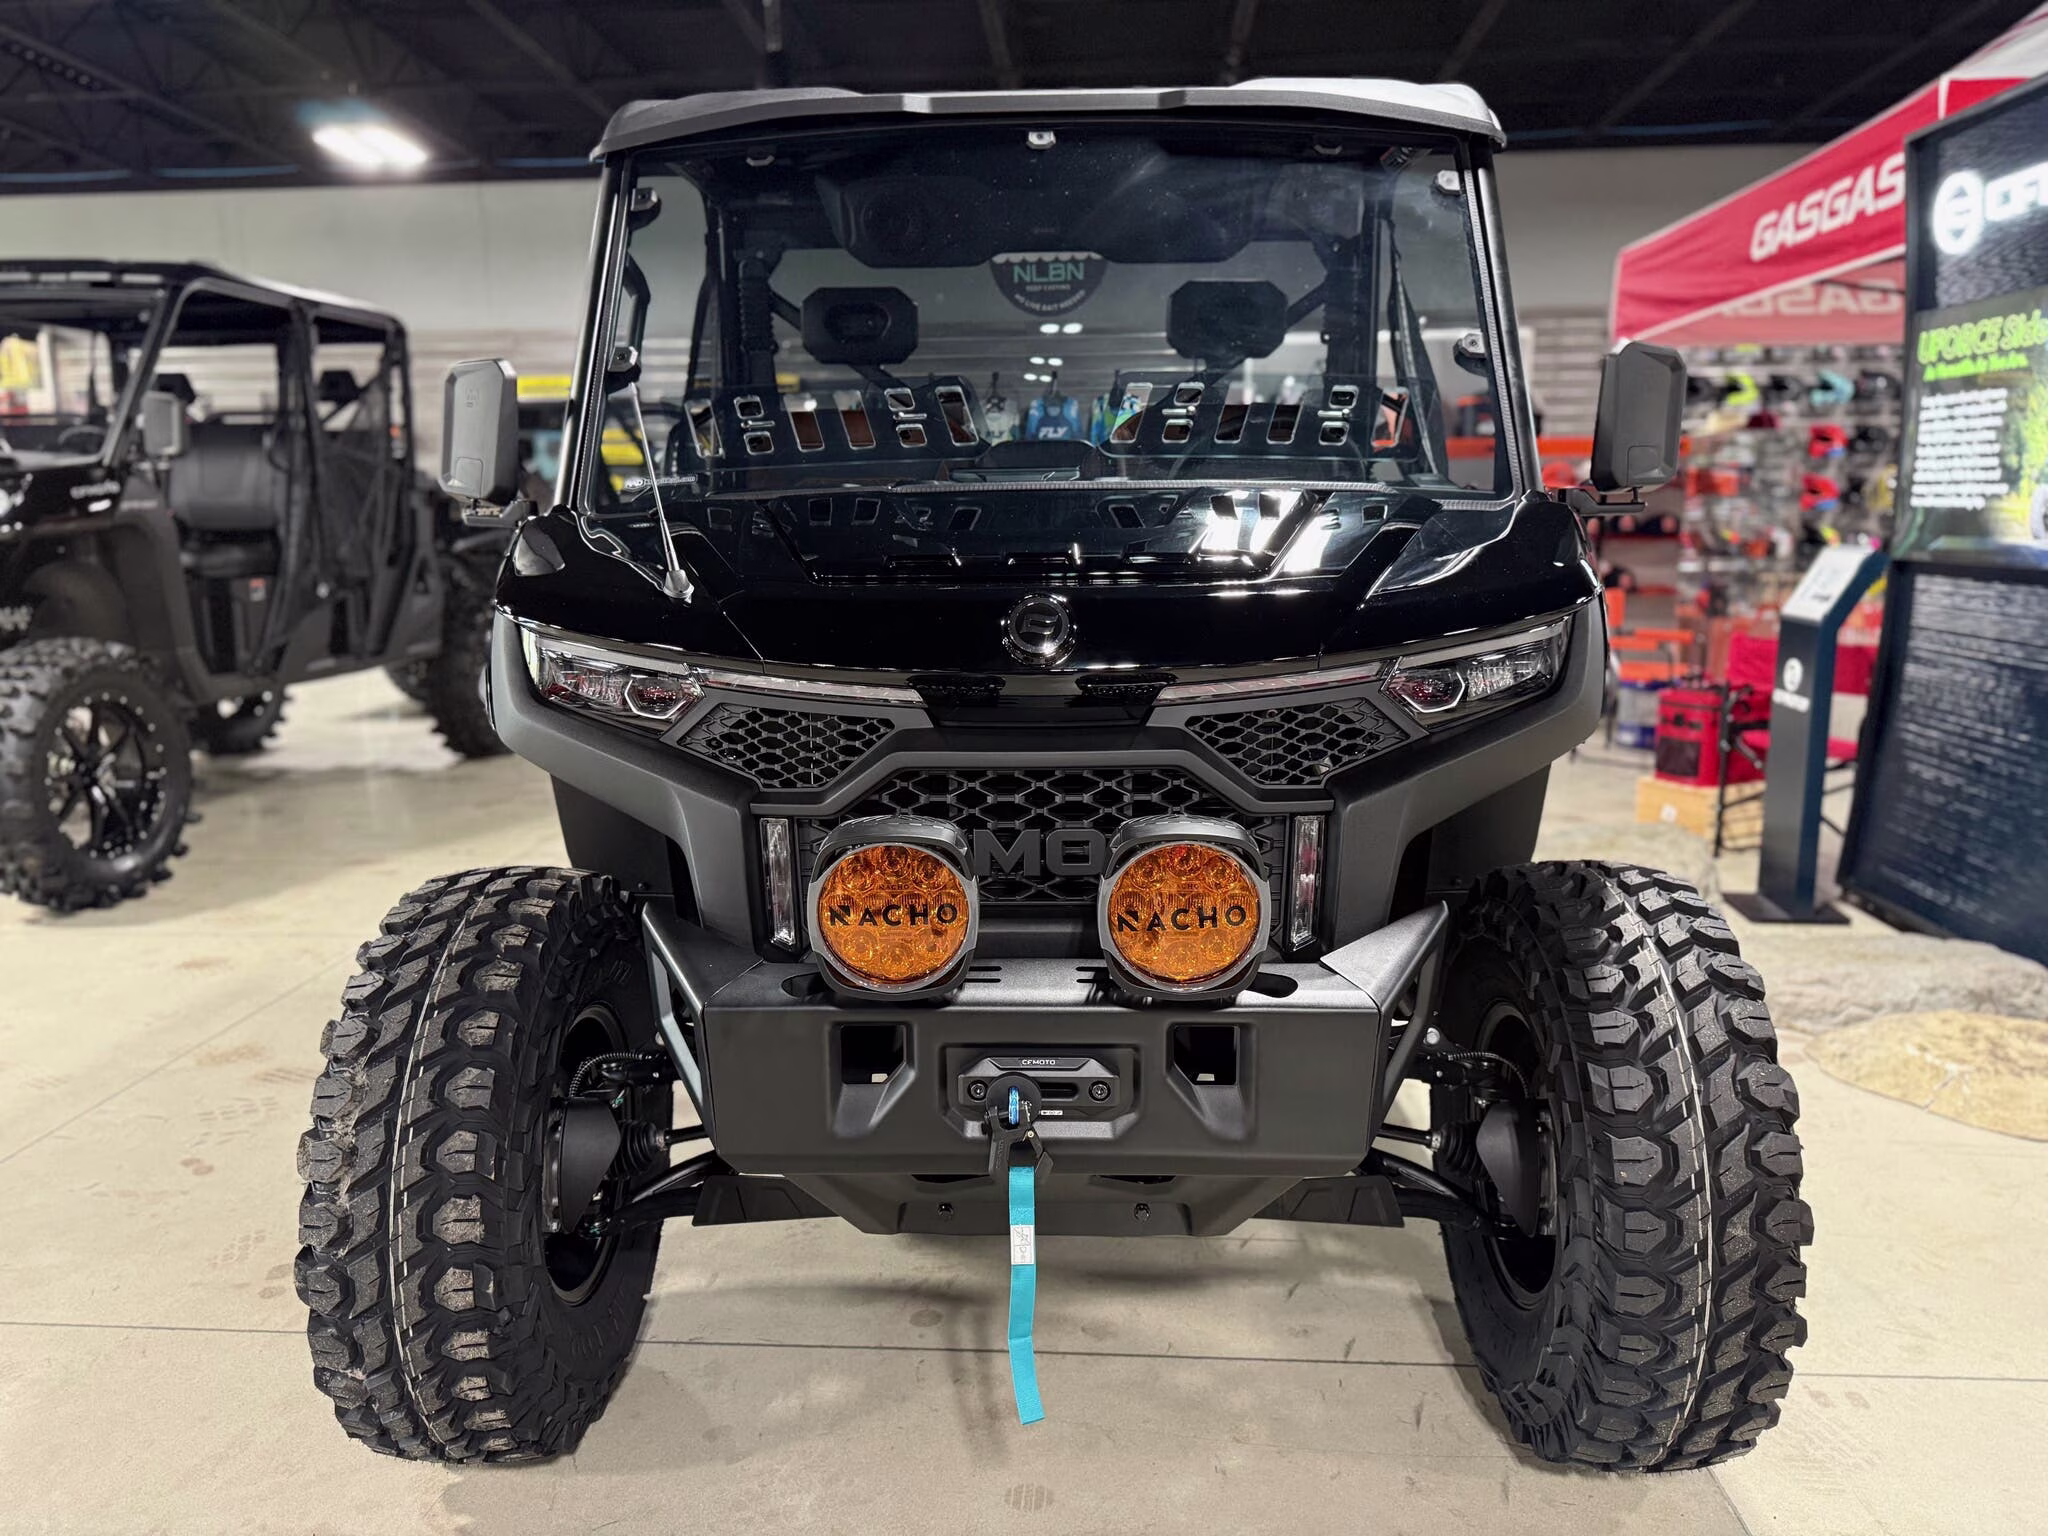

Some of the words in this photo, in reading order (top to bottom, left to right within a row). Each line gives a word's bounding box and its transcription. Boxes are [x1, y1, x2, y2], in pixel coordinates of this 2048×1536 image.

[1750, 152, 1905, 262] GASGAS
[1013, 262, 1085, 283] NLBN
[1038, 426, 1068, 438] FLY
[829, 903, 958, 926] NACHO
[1117, 905, 1247, 932] NACHO
